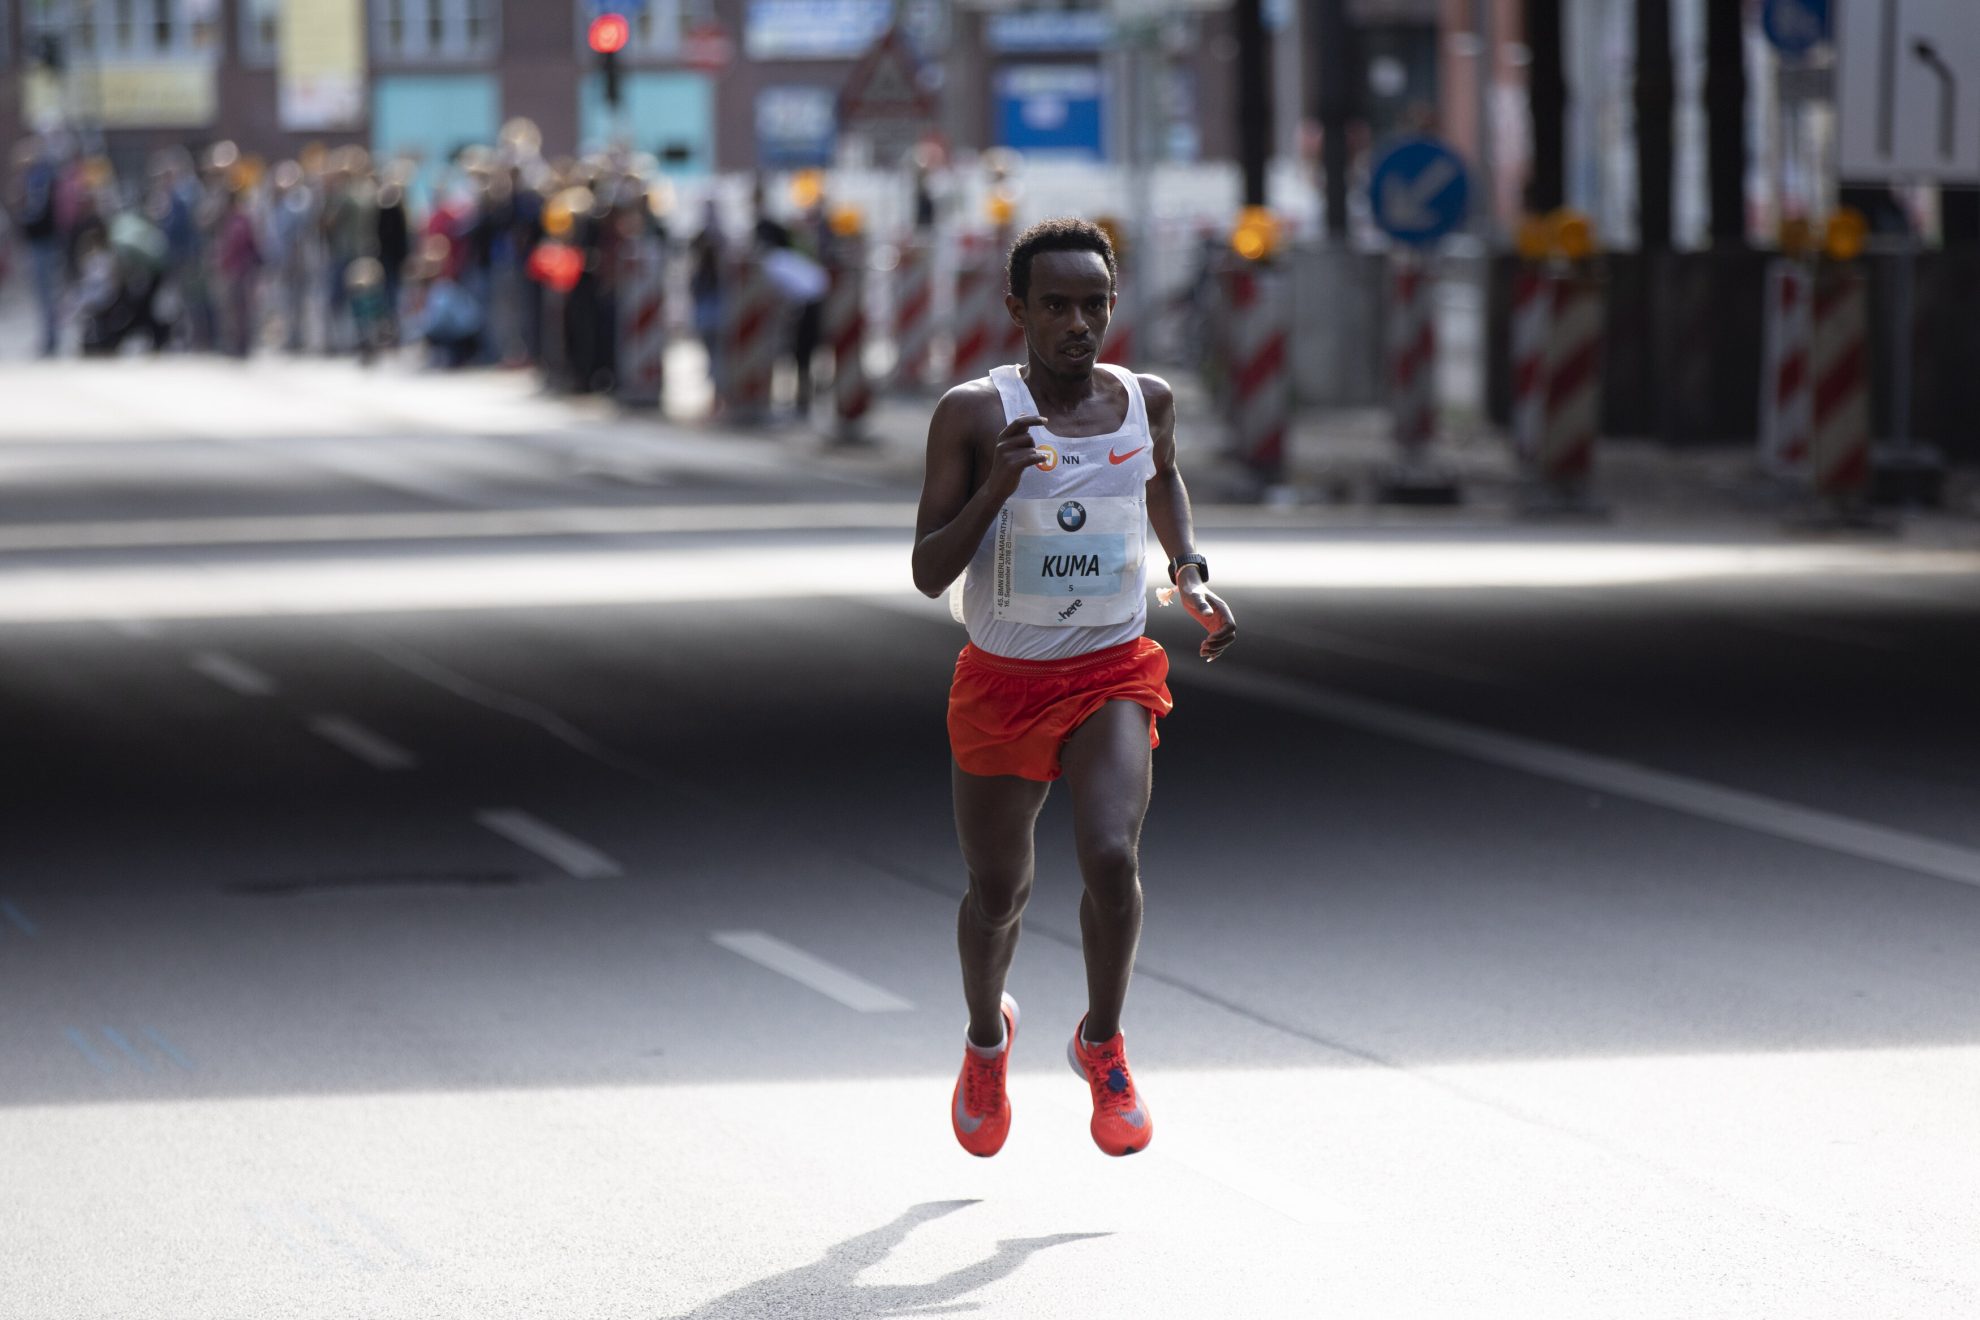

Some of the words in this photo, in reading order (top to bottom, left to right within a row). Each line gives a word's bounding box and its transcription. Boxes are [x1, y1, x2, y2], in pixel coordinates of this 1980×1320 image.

[1062, 455, 1080, 465] NN
[1060, 501, 1083, 512] BMW
[998, 508, 1008, 578] BERLIN-MARATHON
[1041, 554, 1100, 577] KUMA
[1059, 599, 1083, 620] here
